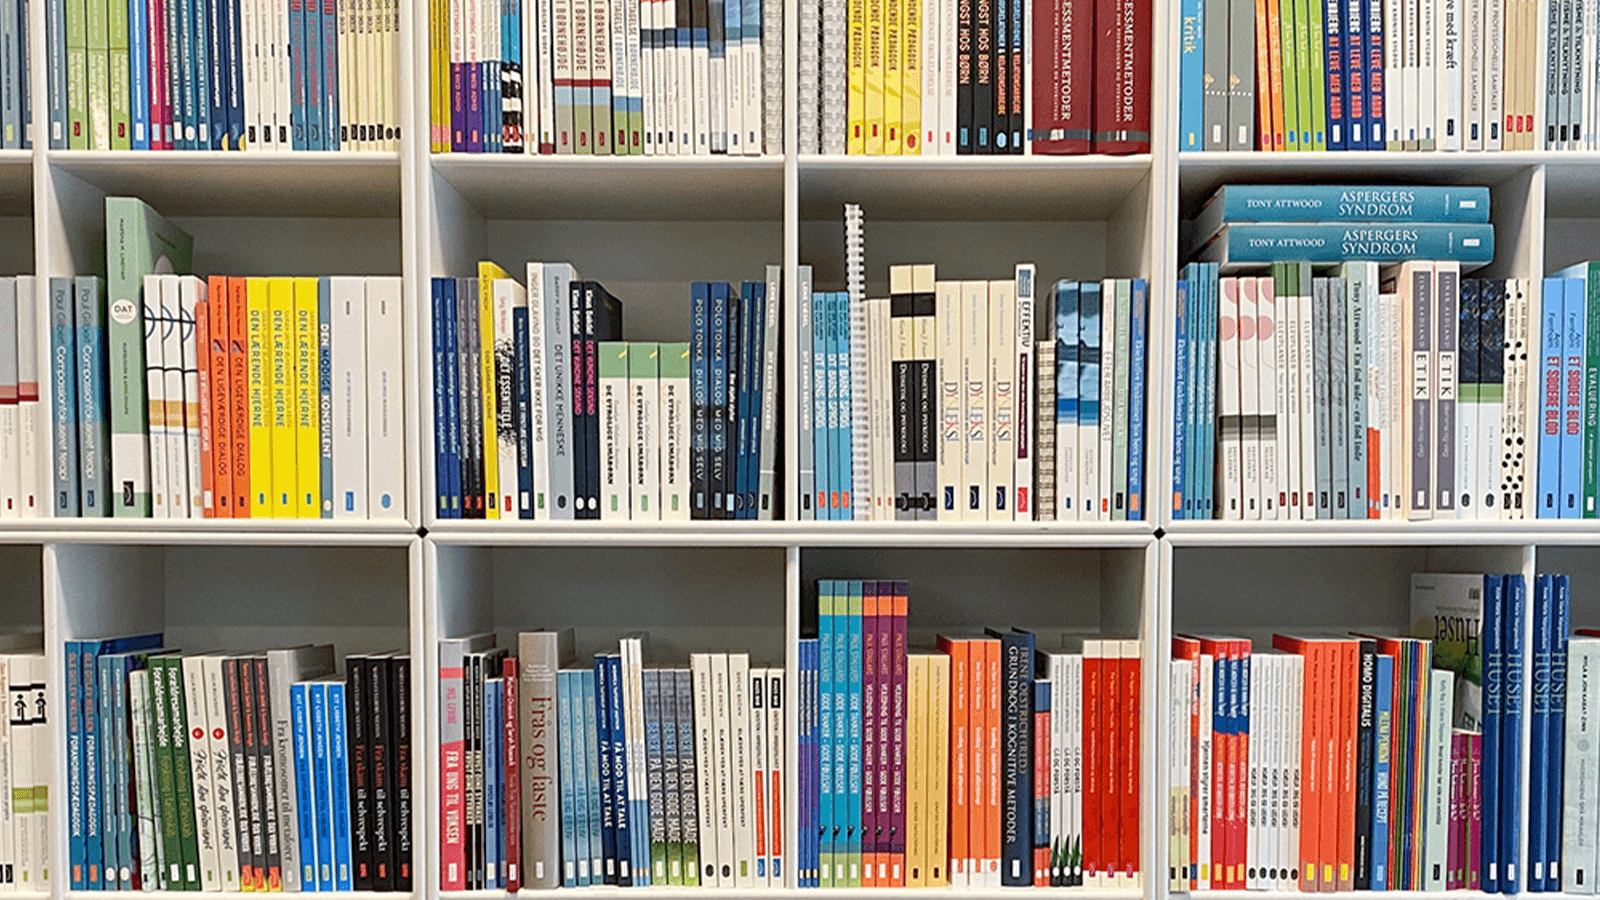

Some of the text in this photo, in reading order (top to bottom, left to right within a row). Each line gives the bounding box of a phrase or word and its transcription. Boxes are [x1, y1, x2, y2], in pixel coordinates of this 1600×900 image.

[1184, 17, 1197, 53] kritik
[1447, 12, 1457, 35] med
[960, 28, 969, 50] HOS
[1062, 0, 1072, 120] ESSMENTMETODER
[1446, 39, 1457, 70] kræft
[960, 54, 970, 84] BØRN
[1247, 200, 1322, 208] TONY ATTWOOD
[1339, 204, 1412, 216] SYNDROM
[1340, 191, 1415, 202] ASPERGERS
[1342, 230, 1418, 241] ASPERGERS
[1342, 243, 1416, 254] SYNDROM
[1352, 281, 1362, 303] Tony
[1021, 302, 1030, 347] EFFEKTIV
[1354, 306, 1362, 345] Attwood
[217, 356, 226, 375] DEN
[251, 310, 261, 427] DEN LÆRENDE HJERNE
[273, 310, 284, 427] DEN LÆRENDE HJERNE
[533, 349, 541, 363] DET
[1354, 353, 1361, 365] En
[534, 365, 542, 387] SKER
[1354, 367, 1362, 382] fod
[1416, 354, 1427, 396] ETIK
[1441, 355, 1452, 397] ETIK
[320, 324, 331, 458] DEN MODIGE KONSULENT
[534, 389, 542, 407] IKKE
[554, 344, 565, 456] DET UNIKKE MENNESKE
[695, 299, 703, 480] POLO TONKA DIALOG MED MIG SELV
[815, 354, 825, 428] DIT BARNS SPROG
[1354, 384, 1362, 401] ude
[1546, 356, 1559, 434] ET SØDERE BLOD
[1588, 368, 1597, 426] EVALUERING
[535, 409, 543, 424] FOR
[944, 382, 959, 441] DYSLEKSI
[1354, 411, 1360, 422] en
[535, 427, 544, 442] MIG
[218, 442, 228, 476] DIALOG
[1354, 441, 1362, 461] inde
[1434, 616, 1480, 656] Huset
[1019, 647, 1028, 679] IRENE
[1363, 654, 1373, 682] HOMO
[1008, 646, 1018, 714] GRUNDBOG
[1488, 652, 1503, 715] HUSET
[1361, 685, 1372, 727] DIGITALIS
[355, 745, 365, 761] Fra
[447, 751, 458, 767] FRA
[526, 697, 552, 821] Frås og faste
[601, 741, 612, 752] FÅ
[1007, 724, 1017, 786] KOGNITIVE
[1201, 740, 1211, 770] Hjernen
[649, 758, 662, 770] PÅ
[1054, 758, 1059, 767] OG
[277, 720, 293, 861] Fra kromosomer til metaforer
[356, 789, 366, 799] til
[602, 779, 611, 791] TIL
[650, 773, 662, 789] DEN
[603, 794, 611, 804] AT
[356, 801, 368, 851] selvrespekt
[604, 806, 612, 827] TALE
[1006, 789, 1016, 843] METODER
